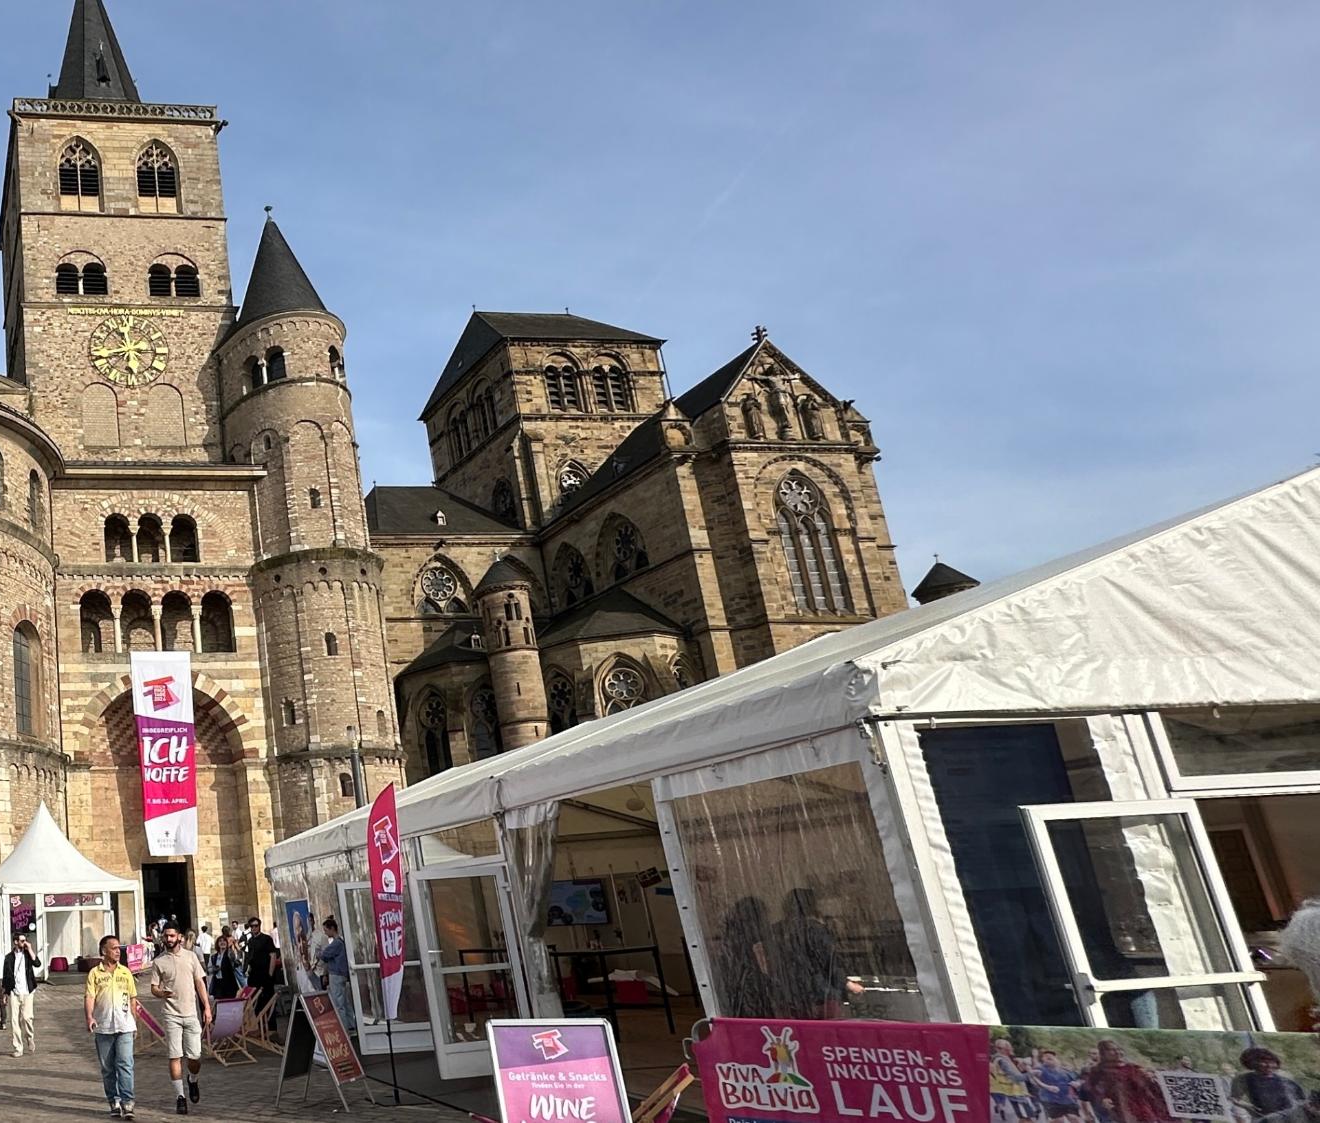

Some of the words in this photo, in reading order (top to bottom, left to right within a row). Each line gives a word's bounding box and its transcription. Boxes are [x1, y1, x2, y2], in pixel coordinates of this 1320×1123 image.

[142, 735, 189, 766] ICH
[144, 766, 189, 782] HOFFE
[822, 1046, 933, 1066] SPENDEN-
[940, 1051, 959, 1068] &
[508, 1071, 555, 1082] Getränke
[558, 1072, 567, 1082] &
[569, 1071, 608, 1082] Snacks
[826, 1063, 963, 1086] INKLUSIONS
[530, 1094, 596, 1121] WINE
[831, 1081, 968, 1123] LAUF
